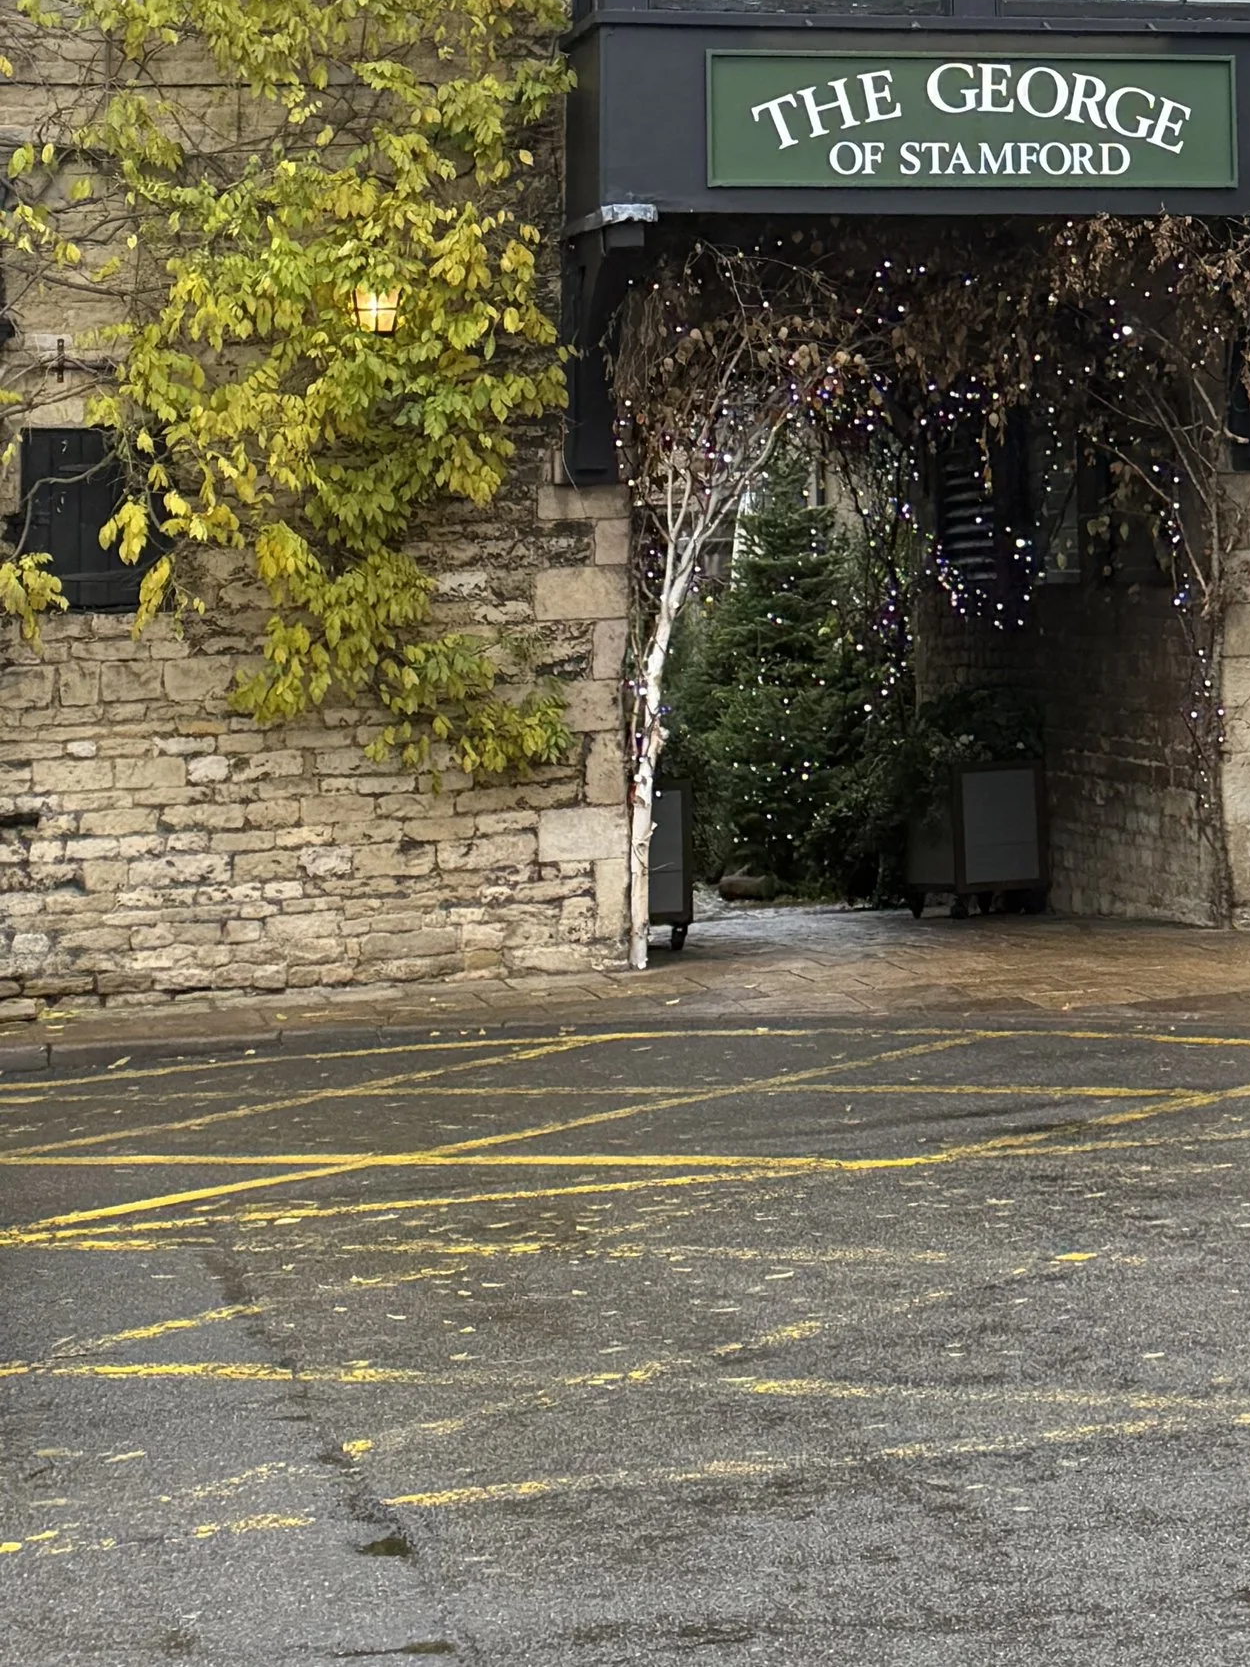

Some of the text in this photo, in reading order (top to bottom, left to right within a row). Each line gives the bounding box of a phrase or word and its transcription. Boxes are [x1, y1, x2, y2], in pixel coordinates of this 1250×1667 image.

[750, 62, 1193, 155] THE GEORGE
[828, 141, 1132, 176] OF STAMFORD
